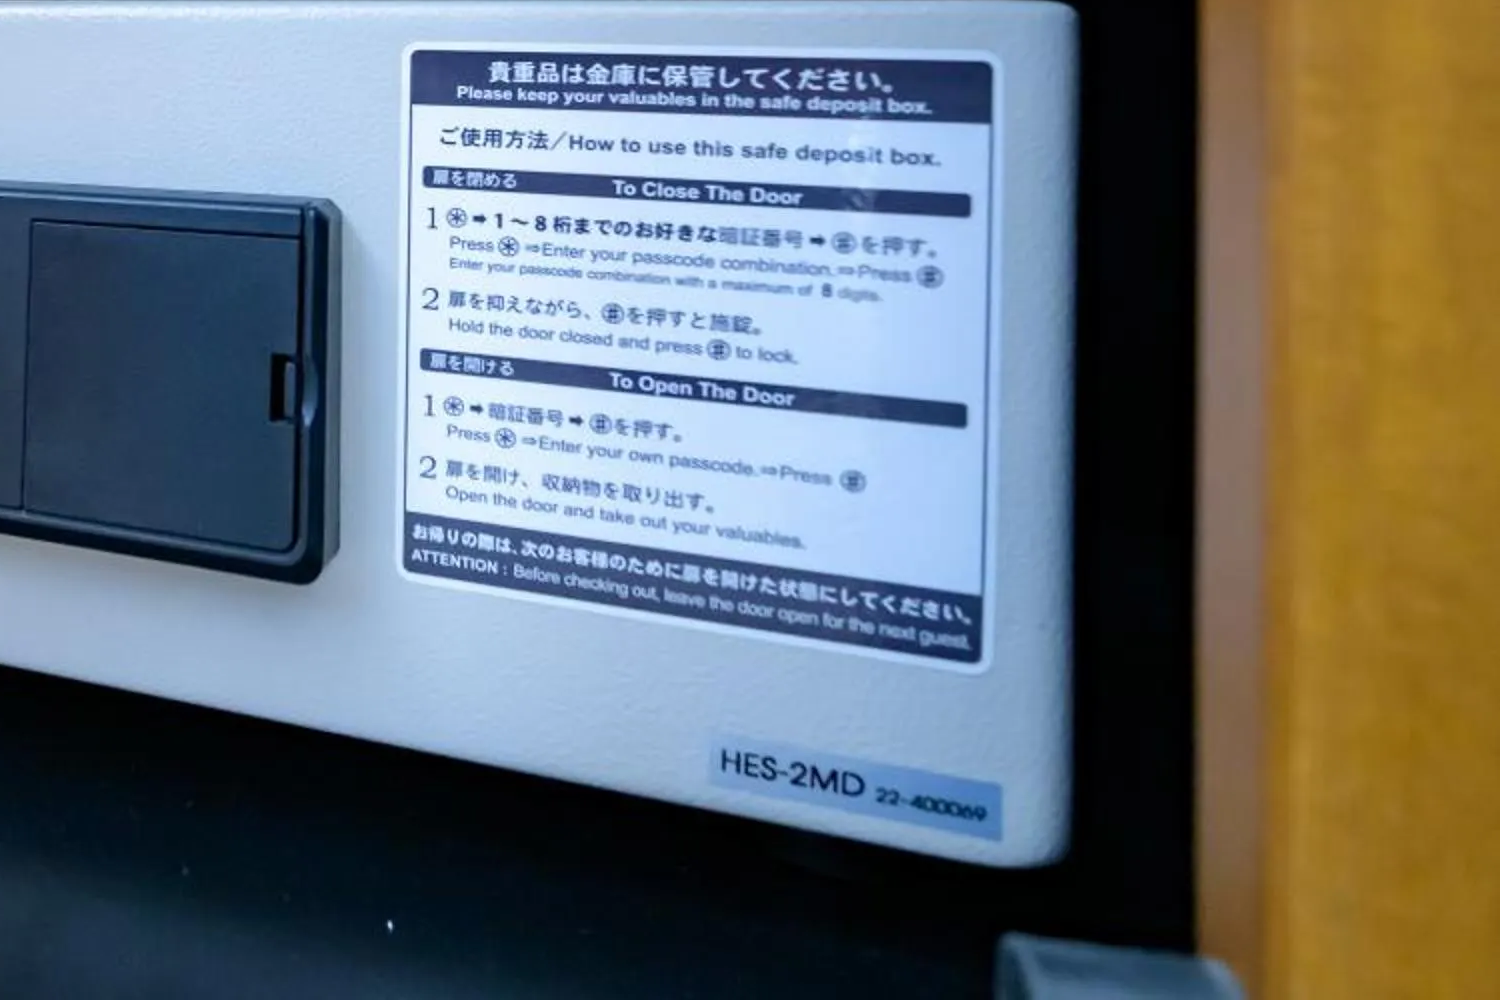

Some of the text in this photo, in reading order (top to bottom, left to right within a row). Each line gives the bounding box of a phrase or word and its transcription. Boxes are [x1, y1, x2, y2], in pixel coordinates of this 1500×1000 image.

[488, 61, 893, 94] 貴重品は金庫に保管してください。
[456, 85, 932, 115] Please keep your valuables in the safe deposit box.
[621, 138, 641, 153] to
[648, 141, 686, 156] use
[693, 140, 733, 157] this
[741, 142, 788, 159] safe
[795, 143, 884, 165] deposit
[890, 148, 941, 167] box.
[432, 169, 517, 189] 扉を閉める
[612, 179, 803, 205] To Close The Door
[427, 207, 438, 230] 1
[449, 235, 494, 251] Press
[590, 247, 626, 263] your
[631, 250, 715, 269] passcode
[449, 257, 483, 270] Enter
[487, 261, 516, 275] your
[519, 263, 583, 279] passcode
[586, 266, 671, 285] combination
[674, 274, 705, 287] with
[421, 287, 440, 311] 2
[449, 317, 485, 335] Hold
[488, 322, 513, 338] the
[518, 324, 554, 341] door
[559, 328, 613, 347] closed
[618, 332, 650, 350] and
[654, 340, 703, 357] press
[735, 344, 753, 360] to
[757, 348, 799, 365] lock.
[429, 352, 515, 377] 扉を開ける
[608, 372, 796, 406] To Open The Door
[424, 394, 436, 417] 1
[446, 424, 491, 443] Press
[586, 442, 623, 460] your
[628, 449, 664, 465] own
[419, 455, 438, 479] 2
[445, 486, 488, 504] Open
[492, 491, 518, 508] the
[522, 496, 558, 514] door
[563, 502, 595, 520] and
[599, 506, 636, 526] take
[640, 513, 668, 530] out
[672, 520, 711, 539] your
[513, 563, 561, 585] Before
[564, 571, 629, 598] checking
[663, 587, 705, 608] leave
[709, 596, 734, 612] the
[738, 599, 774, 618] door
[778, 607, 820, 626] open
[823, 612, 845, 629] for
[849, 616, 875, 635] the
[878, 622, 916, 640] next
[720, 748, 866, 798] HES-2MD
